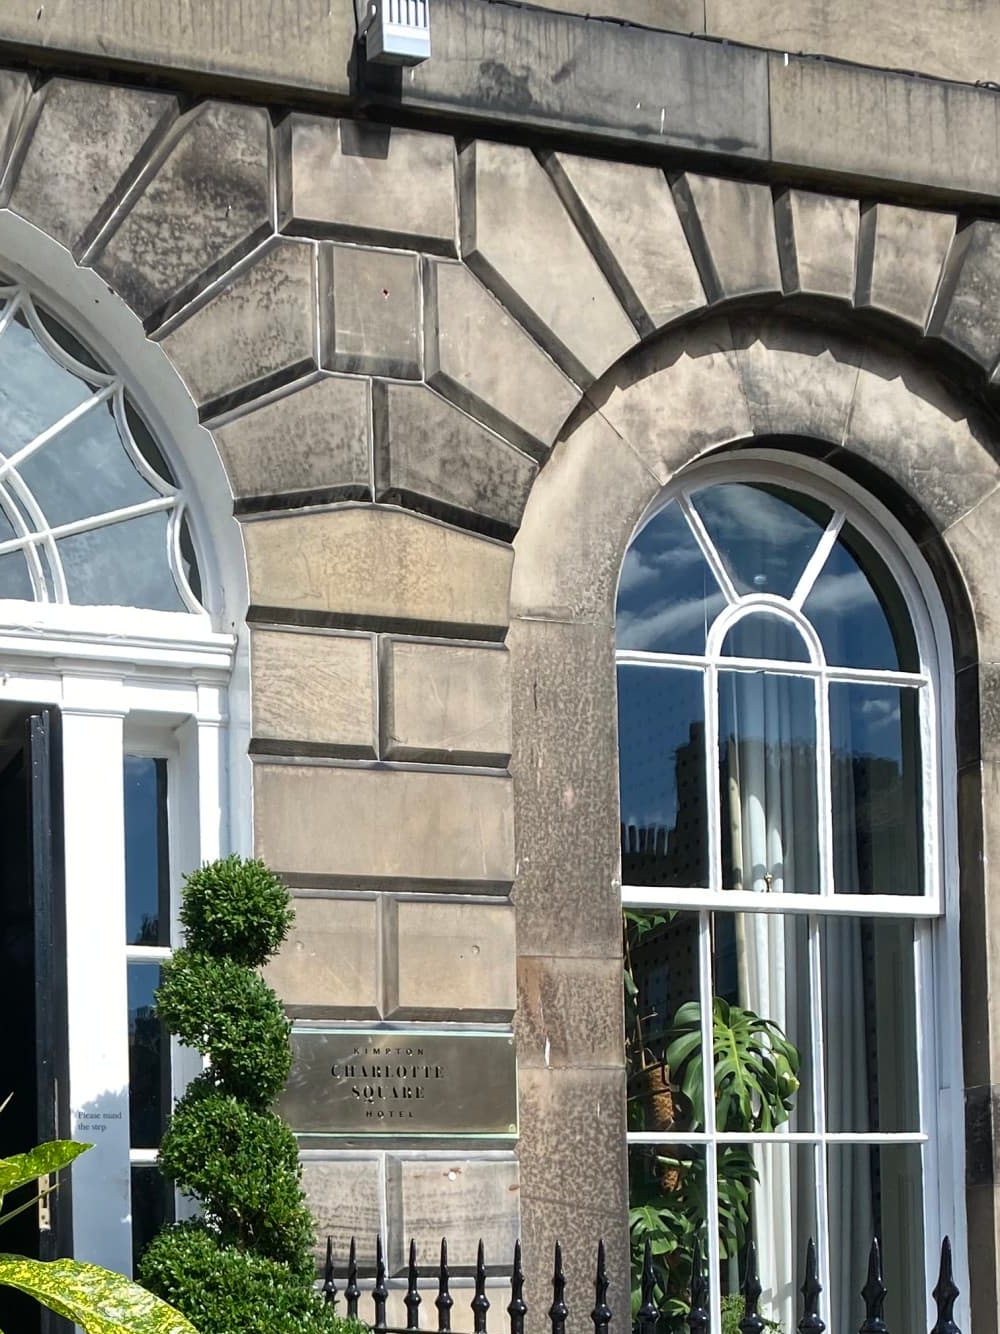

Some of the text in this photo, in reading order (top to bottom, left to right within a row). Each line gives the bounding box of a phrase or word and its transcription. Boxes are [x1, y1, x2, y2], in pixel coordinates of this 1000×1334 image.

[353, 1047, 424, 1055] KIMPTON
[331, 1065, 444, 1078] CHARLOTTE
[351, 1085, 426, 1103] SQUARE
[91, 1124, 106, 1132] step
